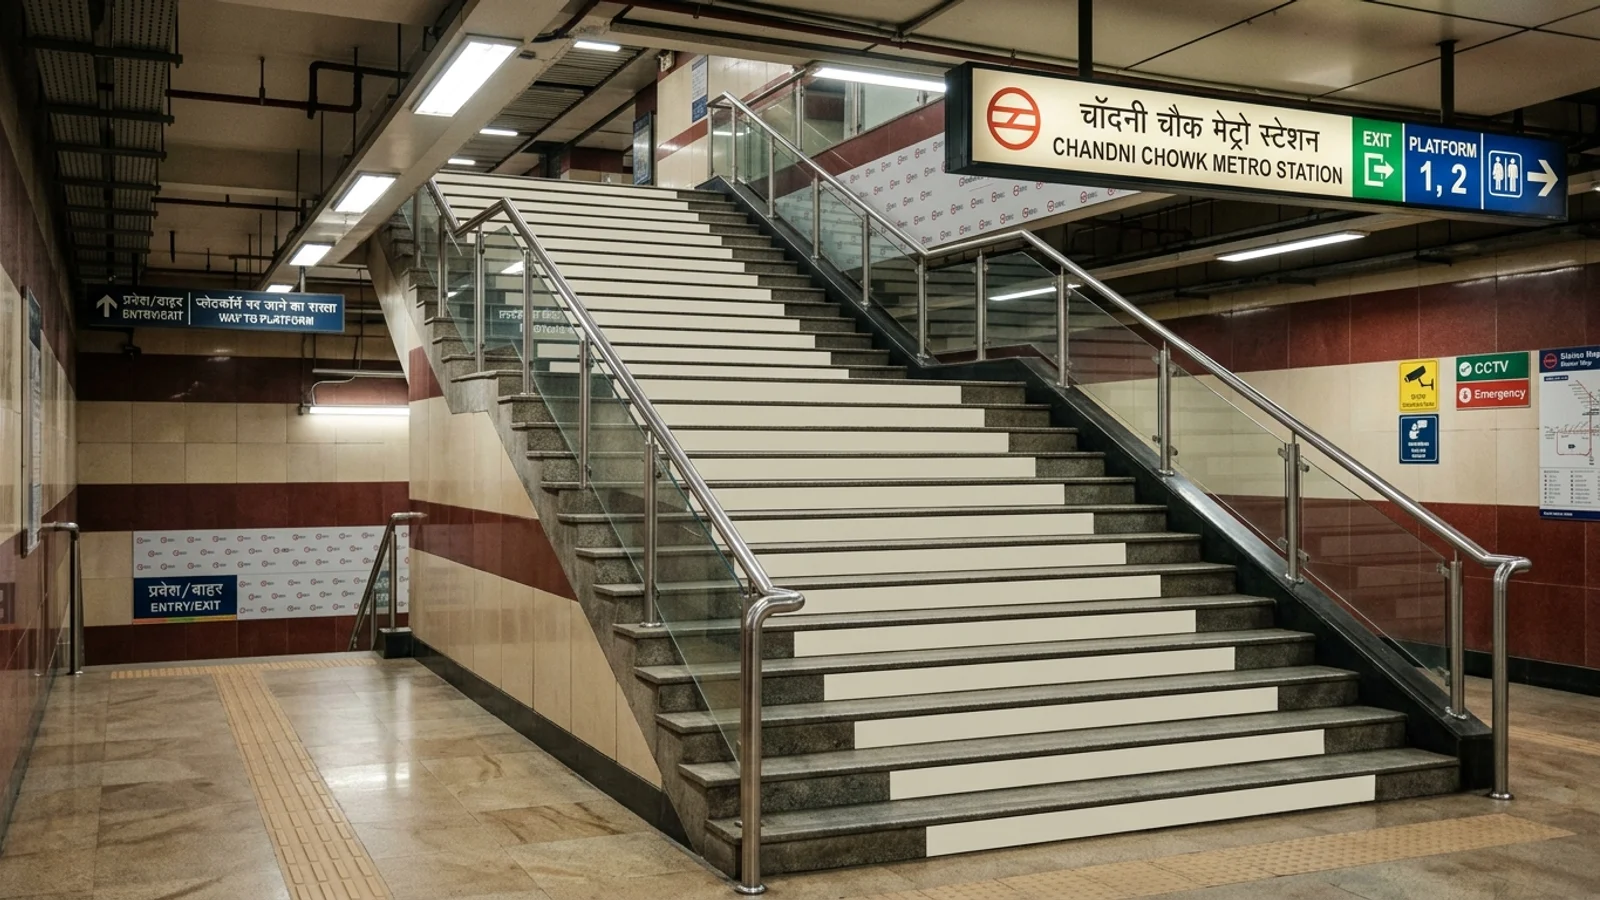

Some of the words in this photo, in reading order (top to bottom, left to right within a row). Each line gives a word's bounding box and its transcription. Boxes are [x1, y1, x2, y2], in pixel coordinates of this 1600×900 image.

[1156, 103, 1204, 139] चौक
[1212, 109, 1252, 151] मेट्रो
[1258, 116, 1320, 153] स्टेशन
[1362, 130, 1392, 148] EXIT
[1409, 136, 1477, 158] PLATFORM
[1053, 137, 1136, 163] CHANDNI
[1141, 146, 1208, 171] CHOWK
[1212, 153, 1272, 177] METRO
[1276, 160, 1343, 185] STATION
[1451, 163, 1467, 195] 2
[1474, 360, 1509, 374] CCTV
[1474, 389, 1526, 401] Emergency
[150, 600, 222, 613] ENTRY/EXIT
